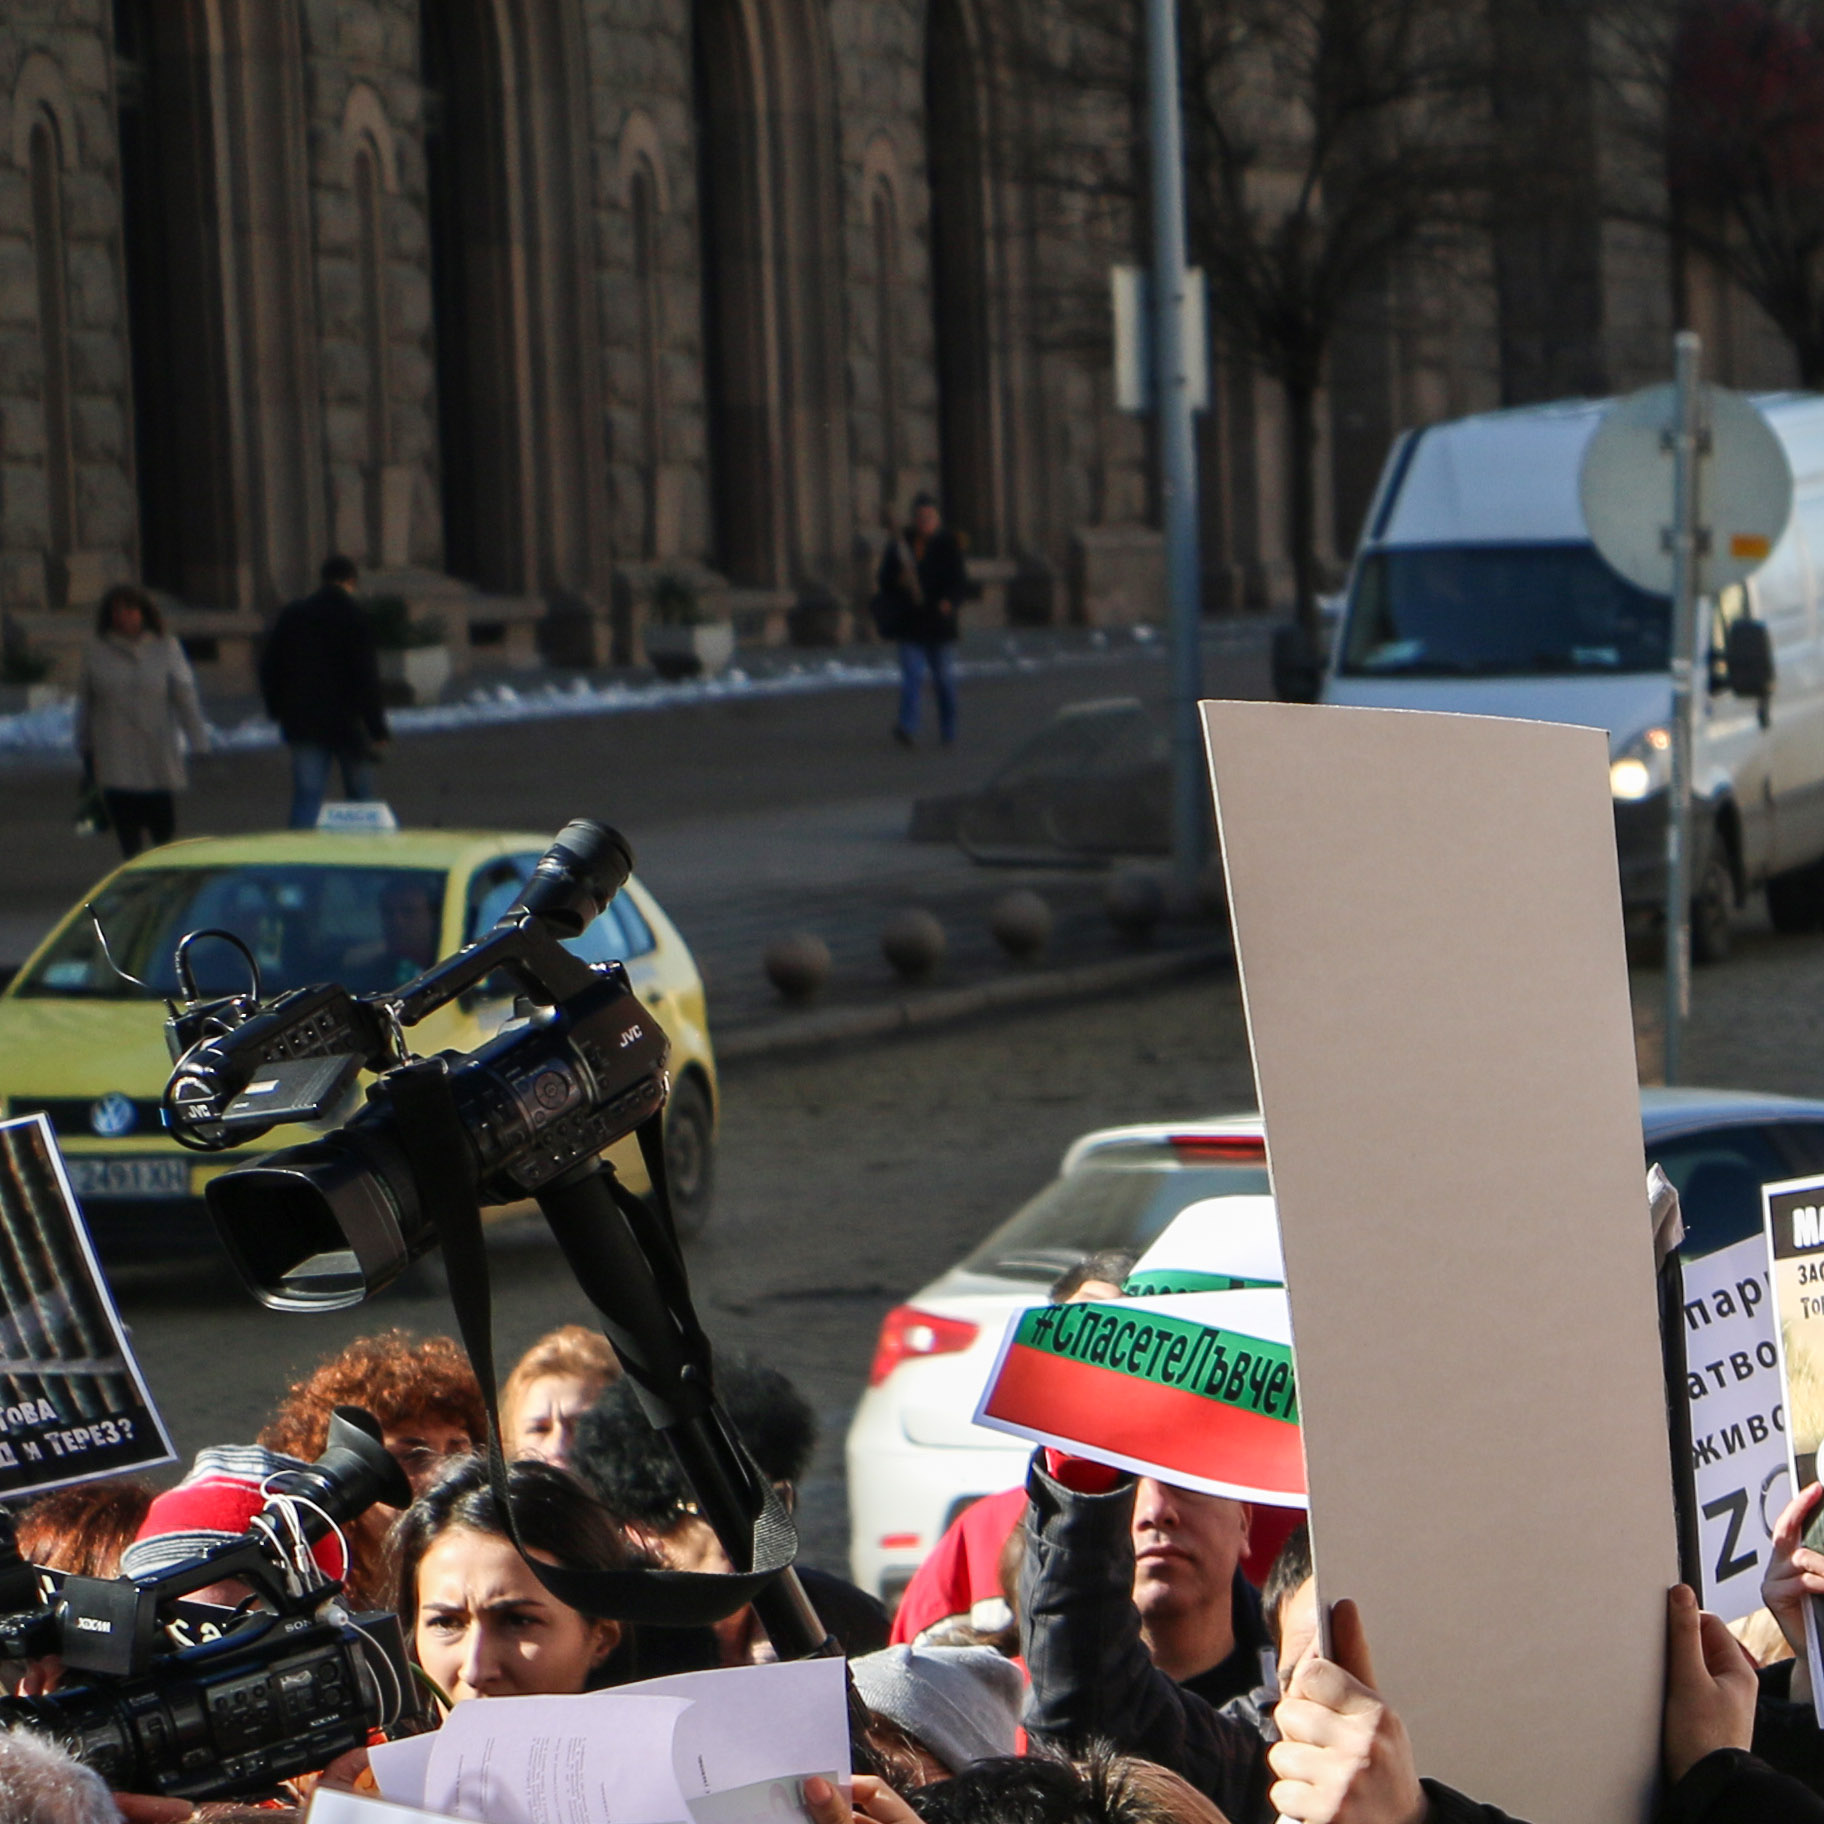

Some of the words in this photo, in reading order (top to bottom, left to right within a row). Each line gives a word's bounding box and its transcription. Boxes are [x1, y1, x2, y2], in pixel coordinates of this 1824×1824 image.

[619, 1024, 643, 1048] JVC
[188, 1104, 211, 1118] JVC
[43, 1417, 135, 1456] ТЕРЕЗ?
